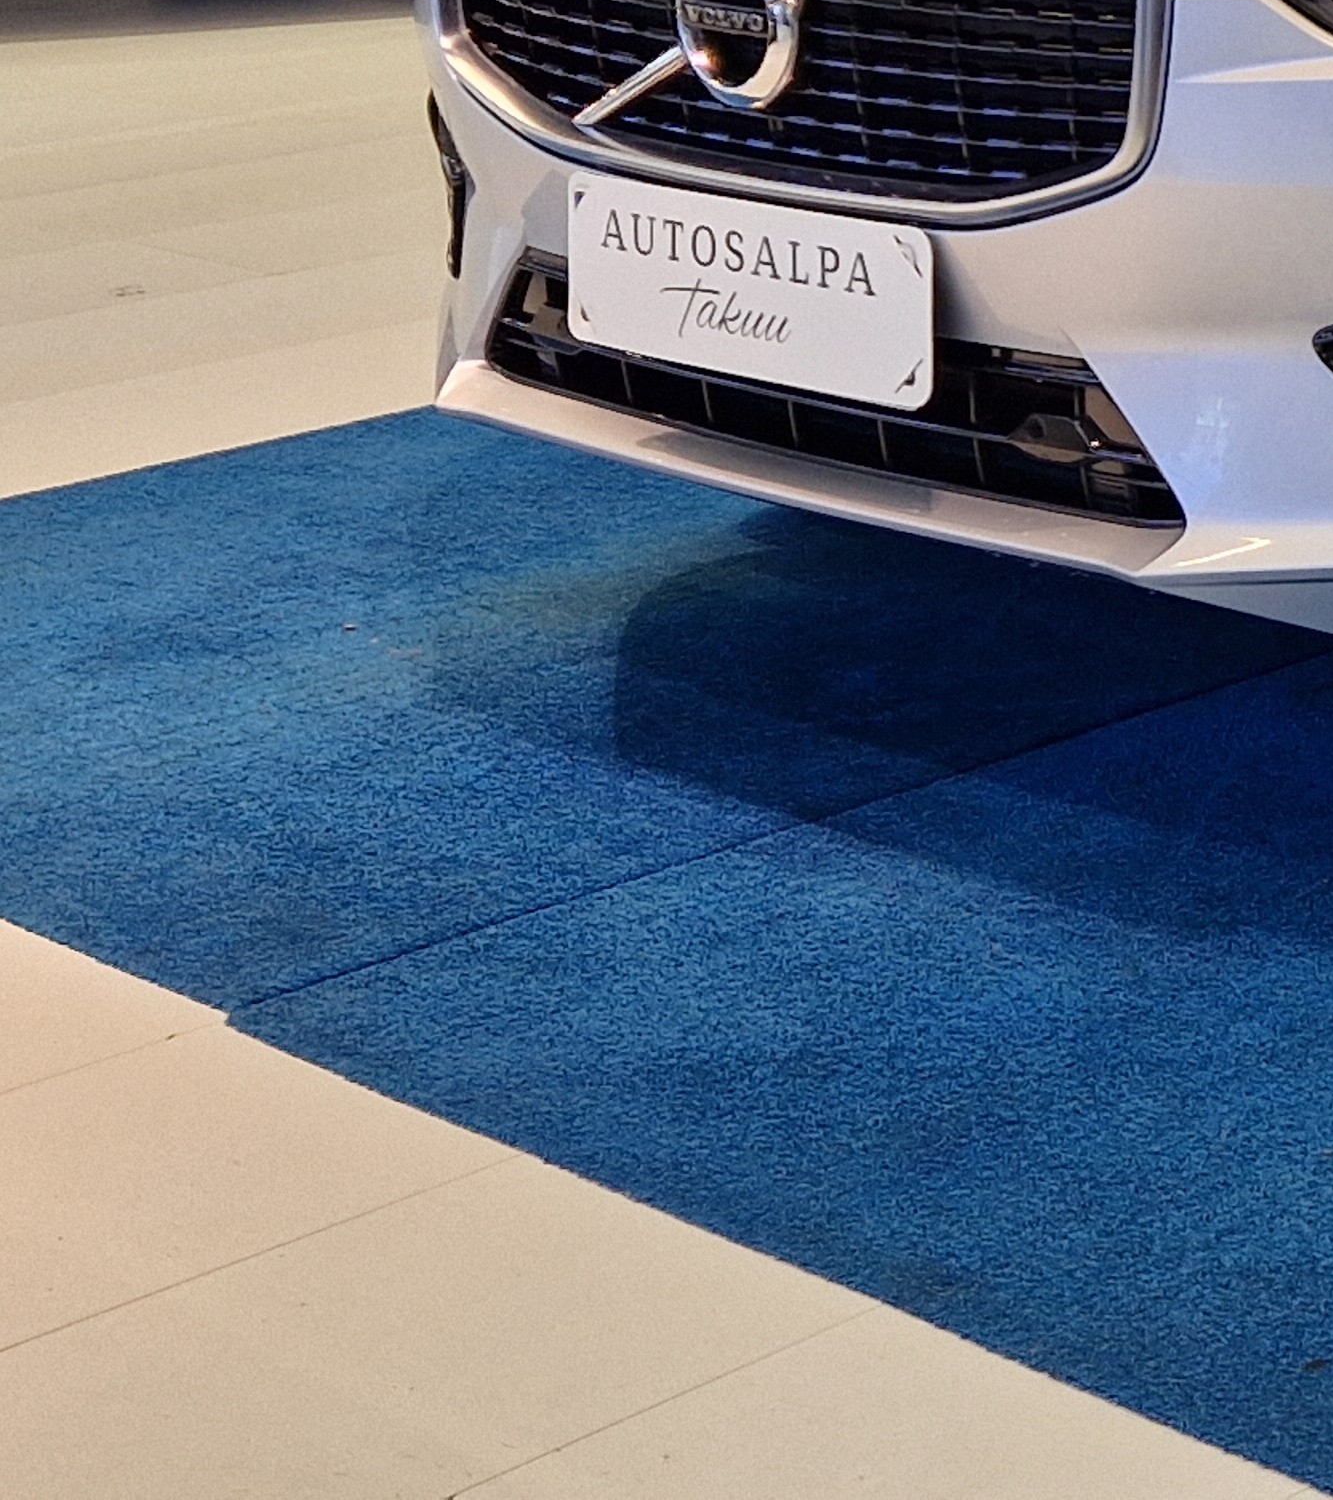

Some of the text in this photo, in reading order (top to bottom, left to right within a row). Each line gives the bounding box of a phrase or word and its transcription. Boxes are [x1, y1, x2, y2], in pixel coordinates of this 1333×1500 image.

[684, 3, 765, 33] VOLVO
[601, 208, 877, 298] AUTOSALPA
[660, 278, 794, 343] Takuu
